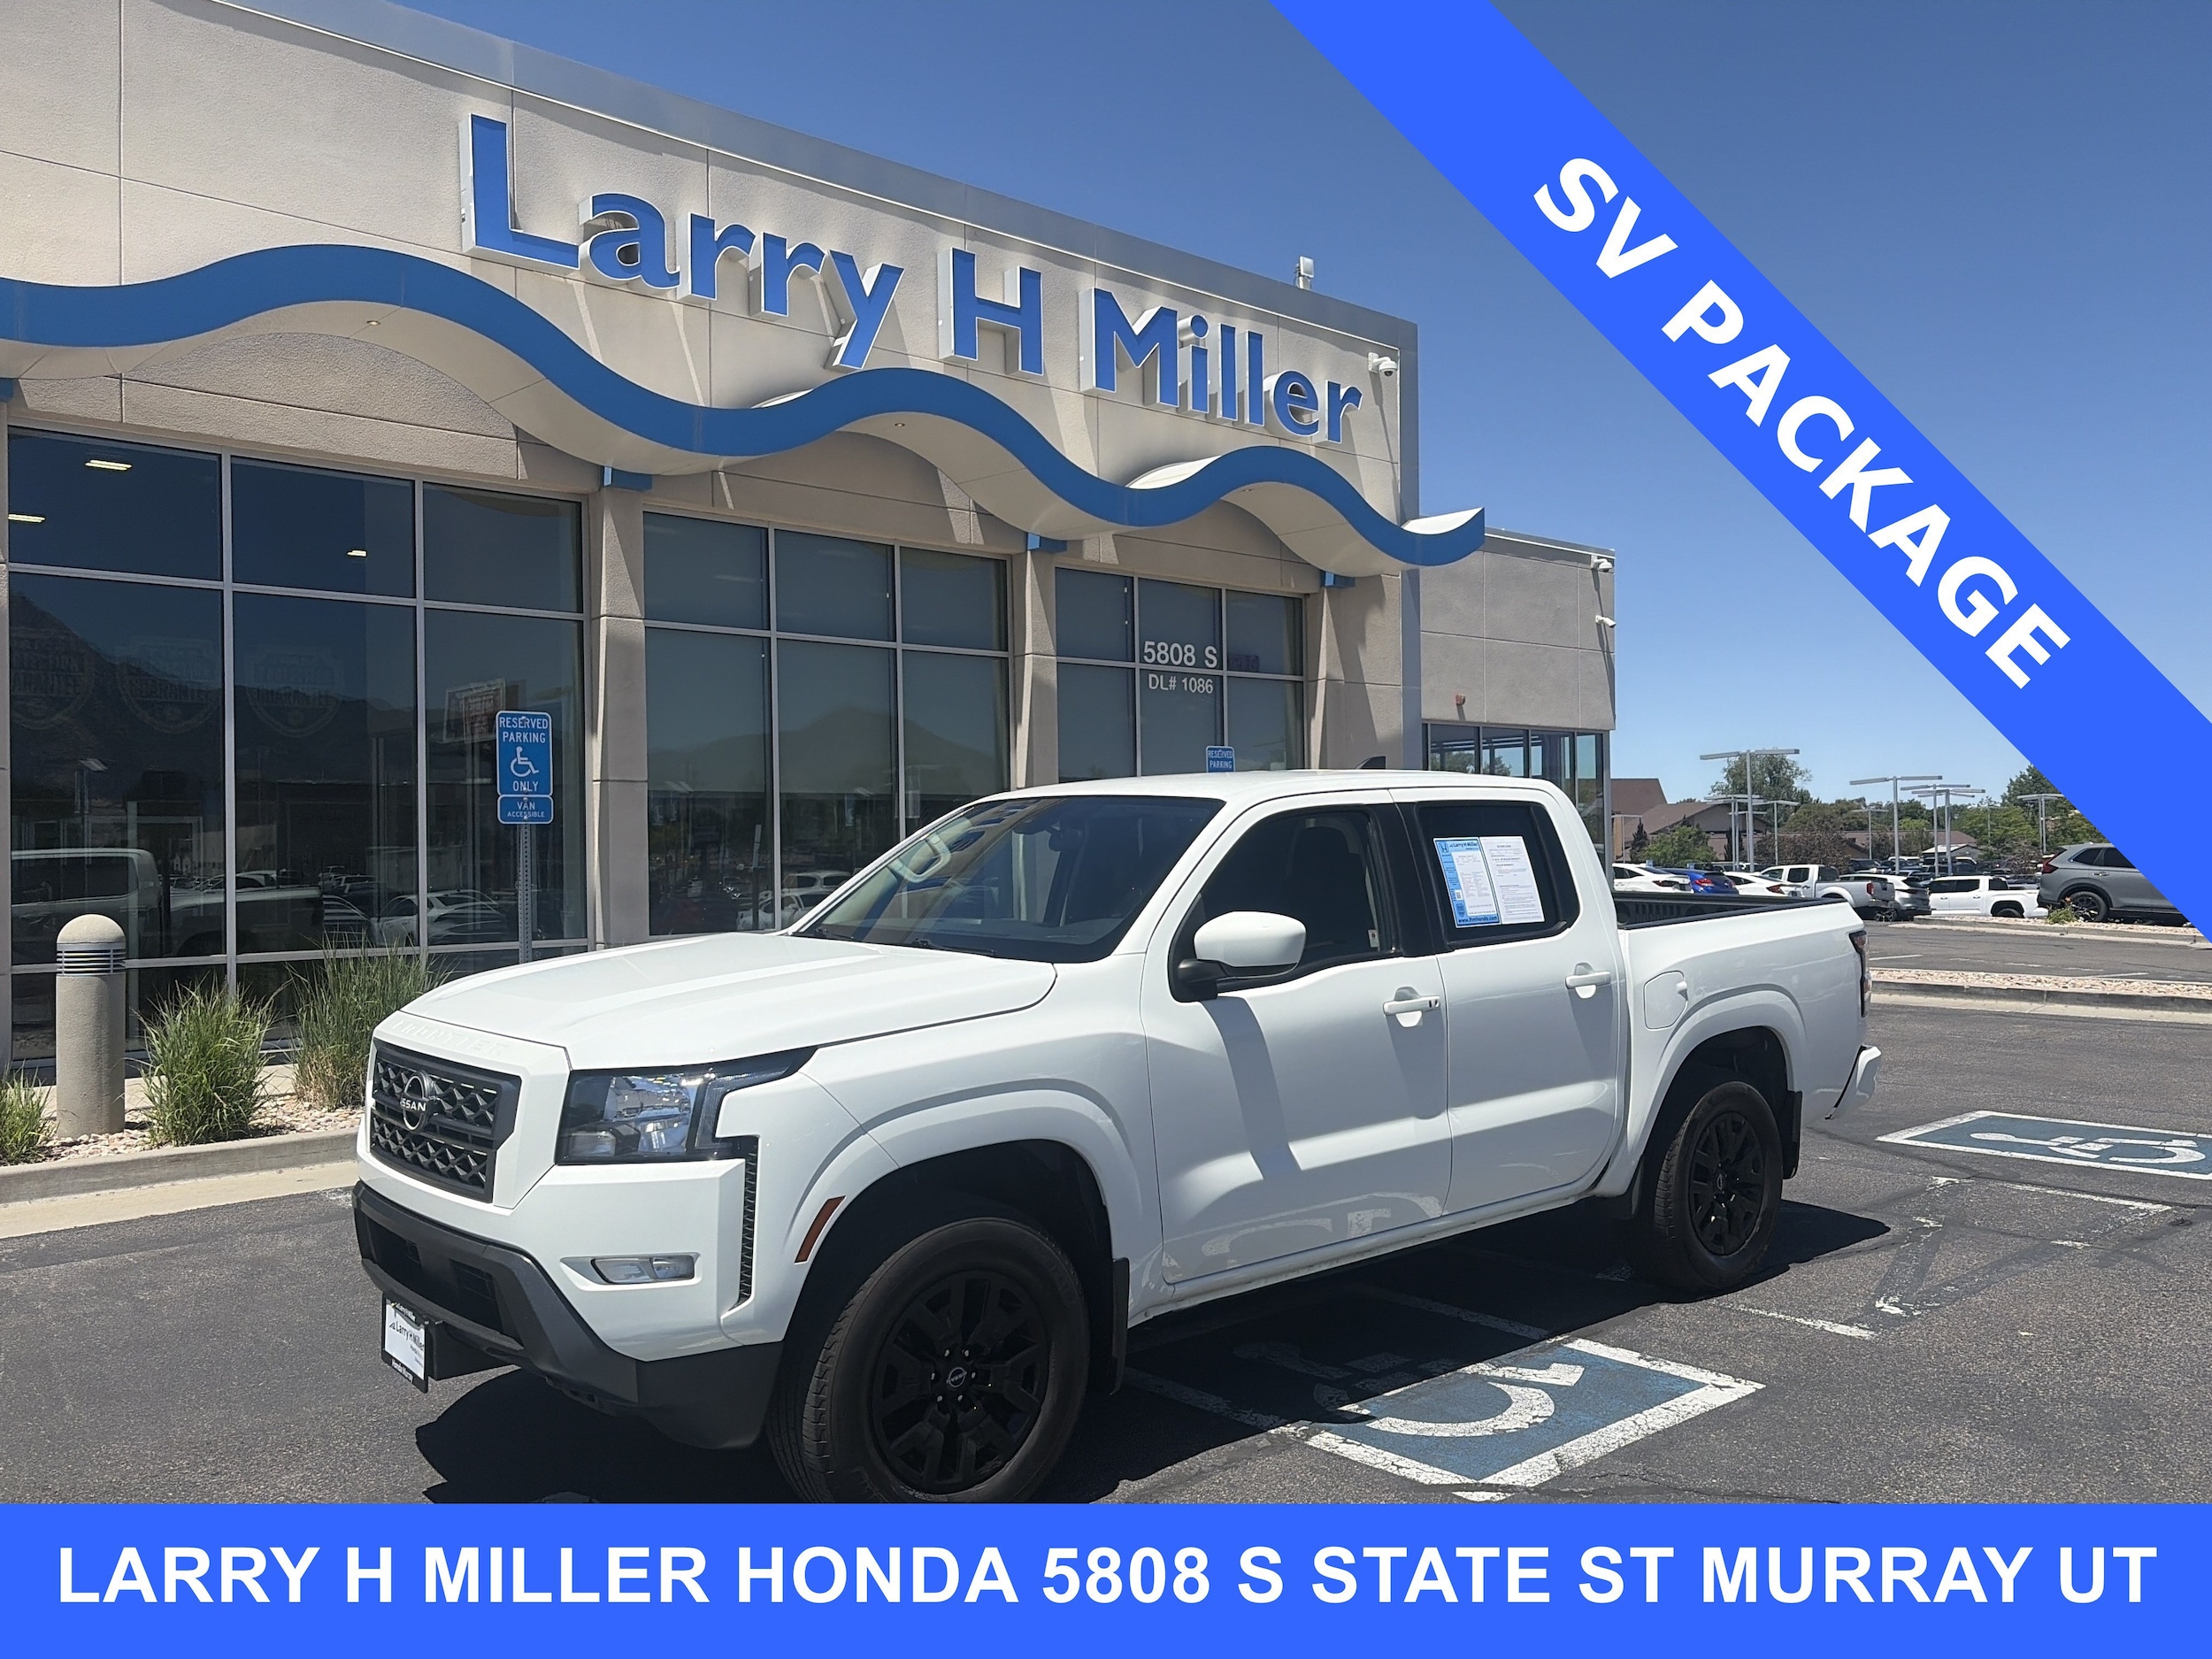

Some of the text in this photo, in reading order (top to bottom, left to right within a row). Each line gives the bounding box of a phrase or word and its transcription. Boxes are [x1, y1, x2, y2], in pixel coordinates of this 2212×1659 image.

[466, 112, 1363, 444] Larry H Miller
[1143, 641, 1196, 667] 5808
[1204, 645, 1217, 669] S
[1148, 673, 1214, 694] DL# 1086
[499, 717, 549, 730] RESERVED
[503, 732, 546, 743] PARKING
[1208, 749, 1233, 759] RESERVED
[512, 780, 539, 792] ONLY
[517, 802, 535, 810] VAN
